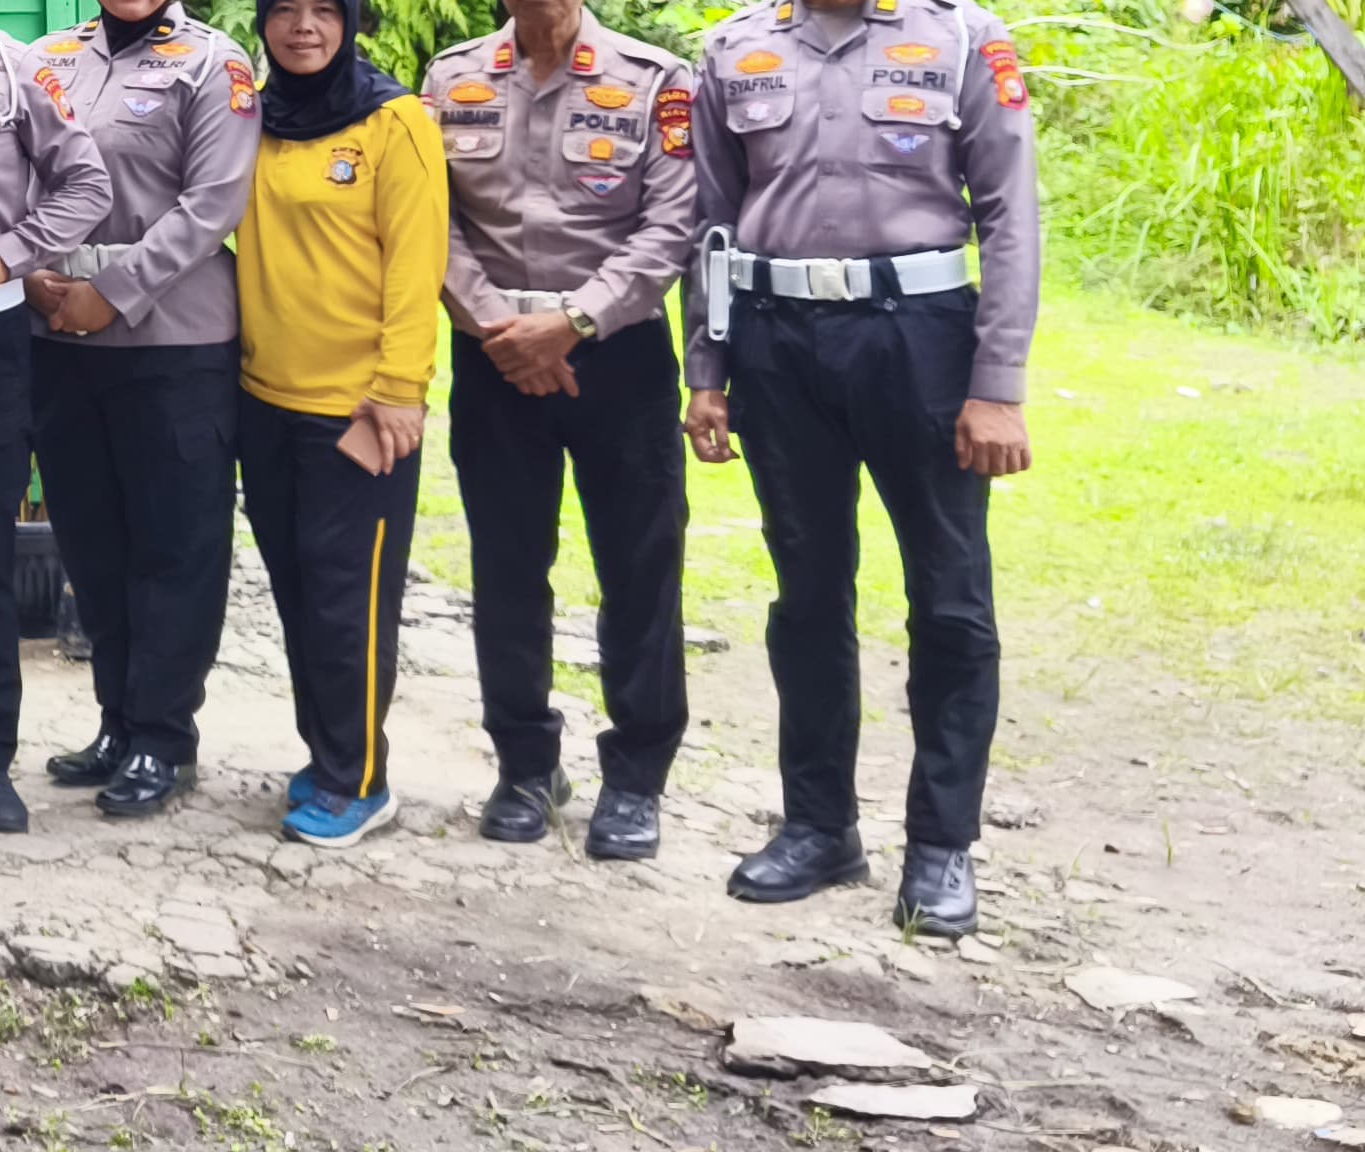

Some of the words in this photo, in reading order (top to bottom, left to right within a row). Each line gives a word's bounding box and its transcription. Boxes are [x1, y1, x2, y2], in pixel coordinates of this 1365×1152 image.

[137, 59, 187, 69] POLRI
[872, 69, 947, 88] POLRI
[570, 112, 638, 137] POLRI
